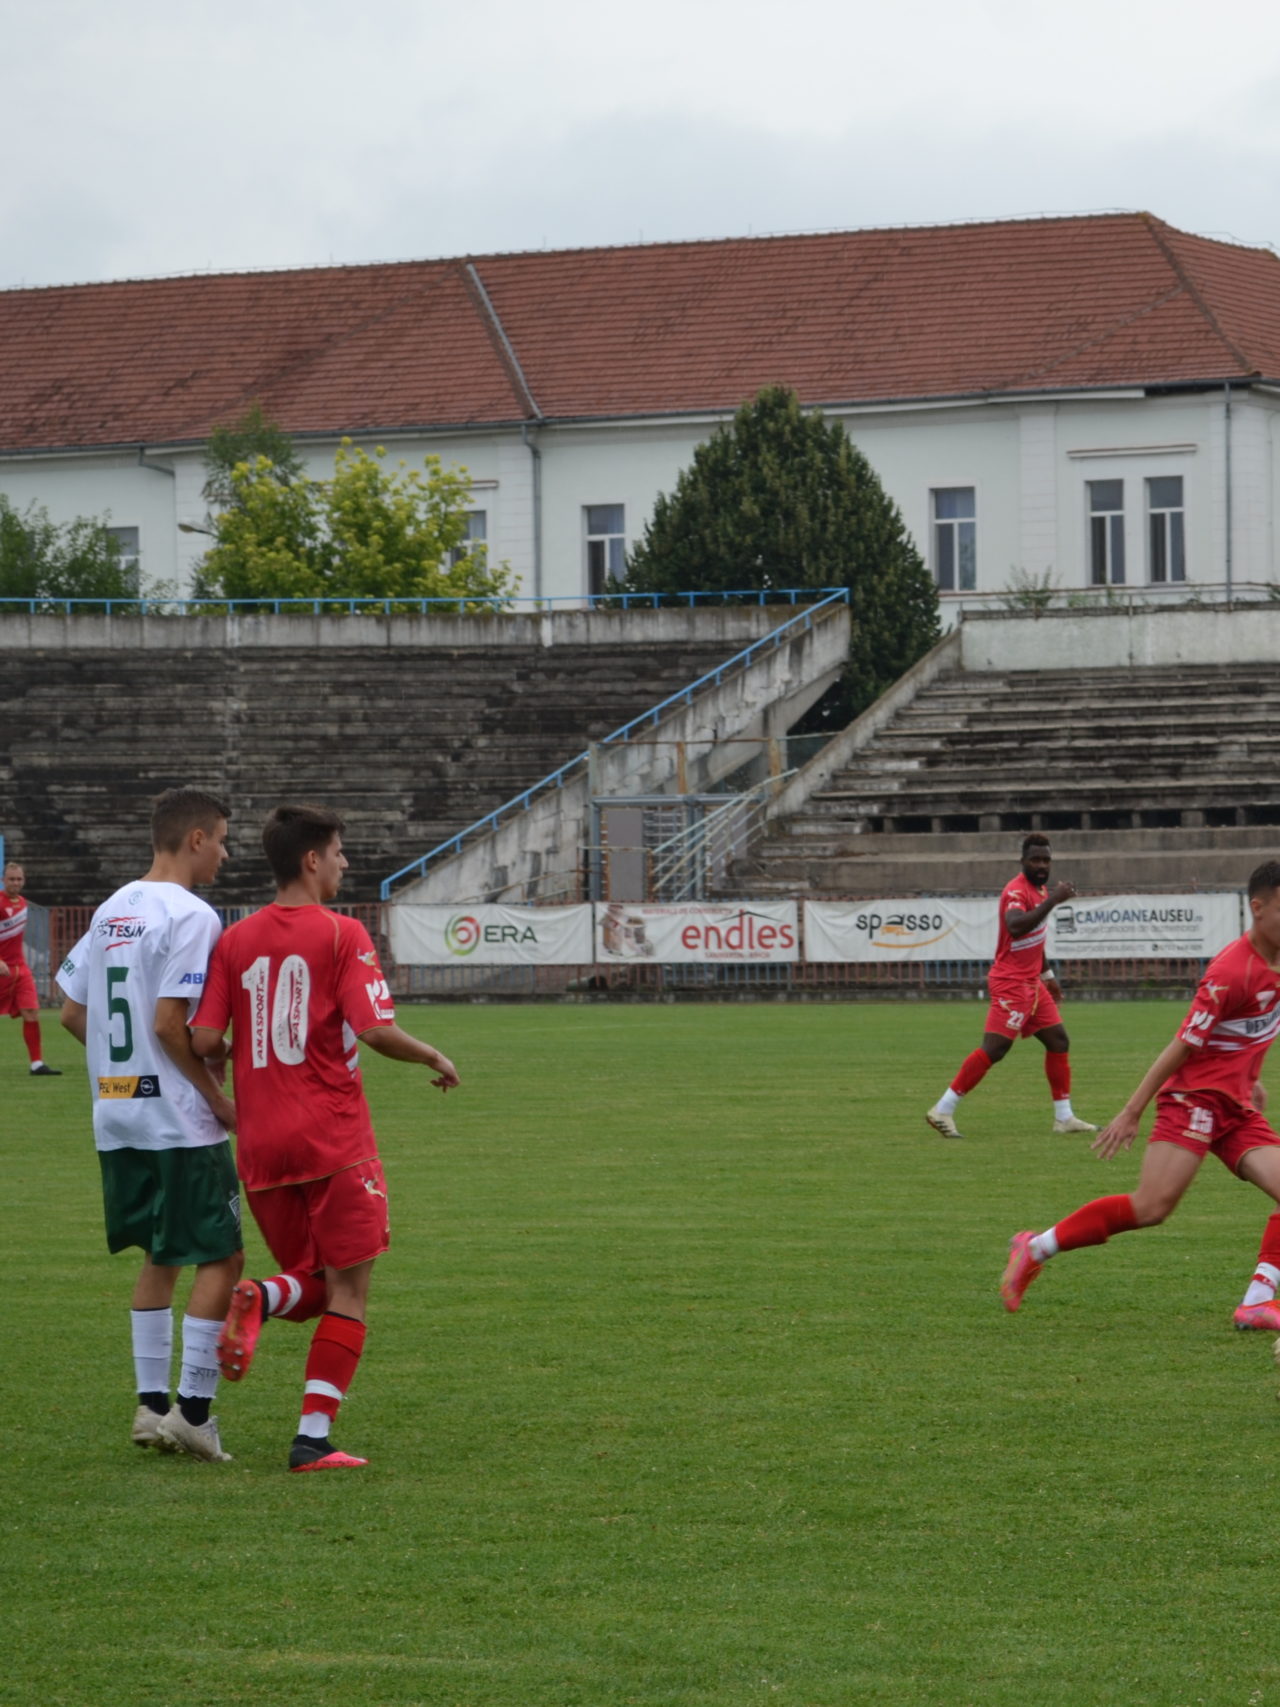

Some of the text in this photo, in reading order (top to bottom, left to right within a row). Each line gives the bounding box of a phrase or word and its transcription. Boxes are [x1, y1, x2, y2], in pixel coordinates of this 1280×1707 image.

[484, 924, 538, 943] ERA
[682, 909, 795, 950] endles
[856, 913, 943, 939] spasso
[107, 966, 133, 1062] 5
[241, 953, 311, 1069] 10
